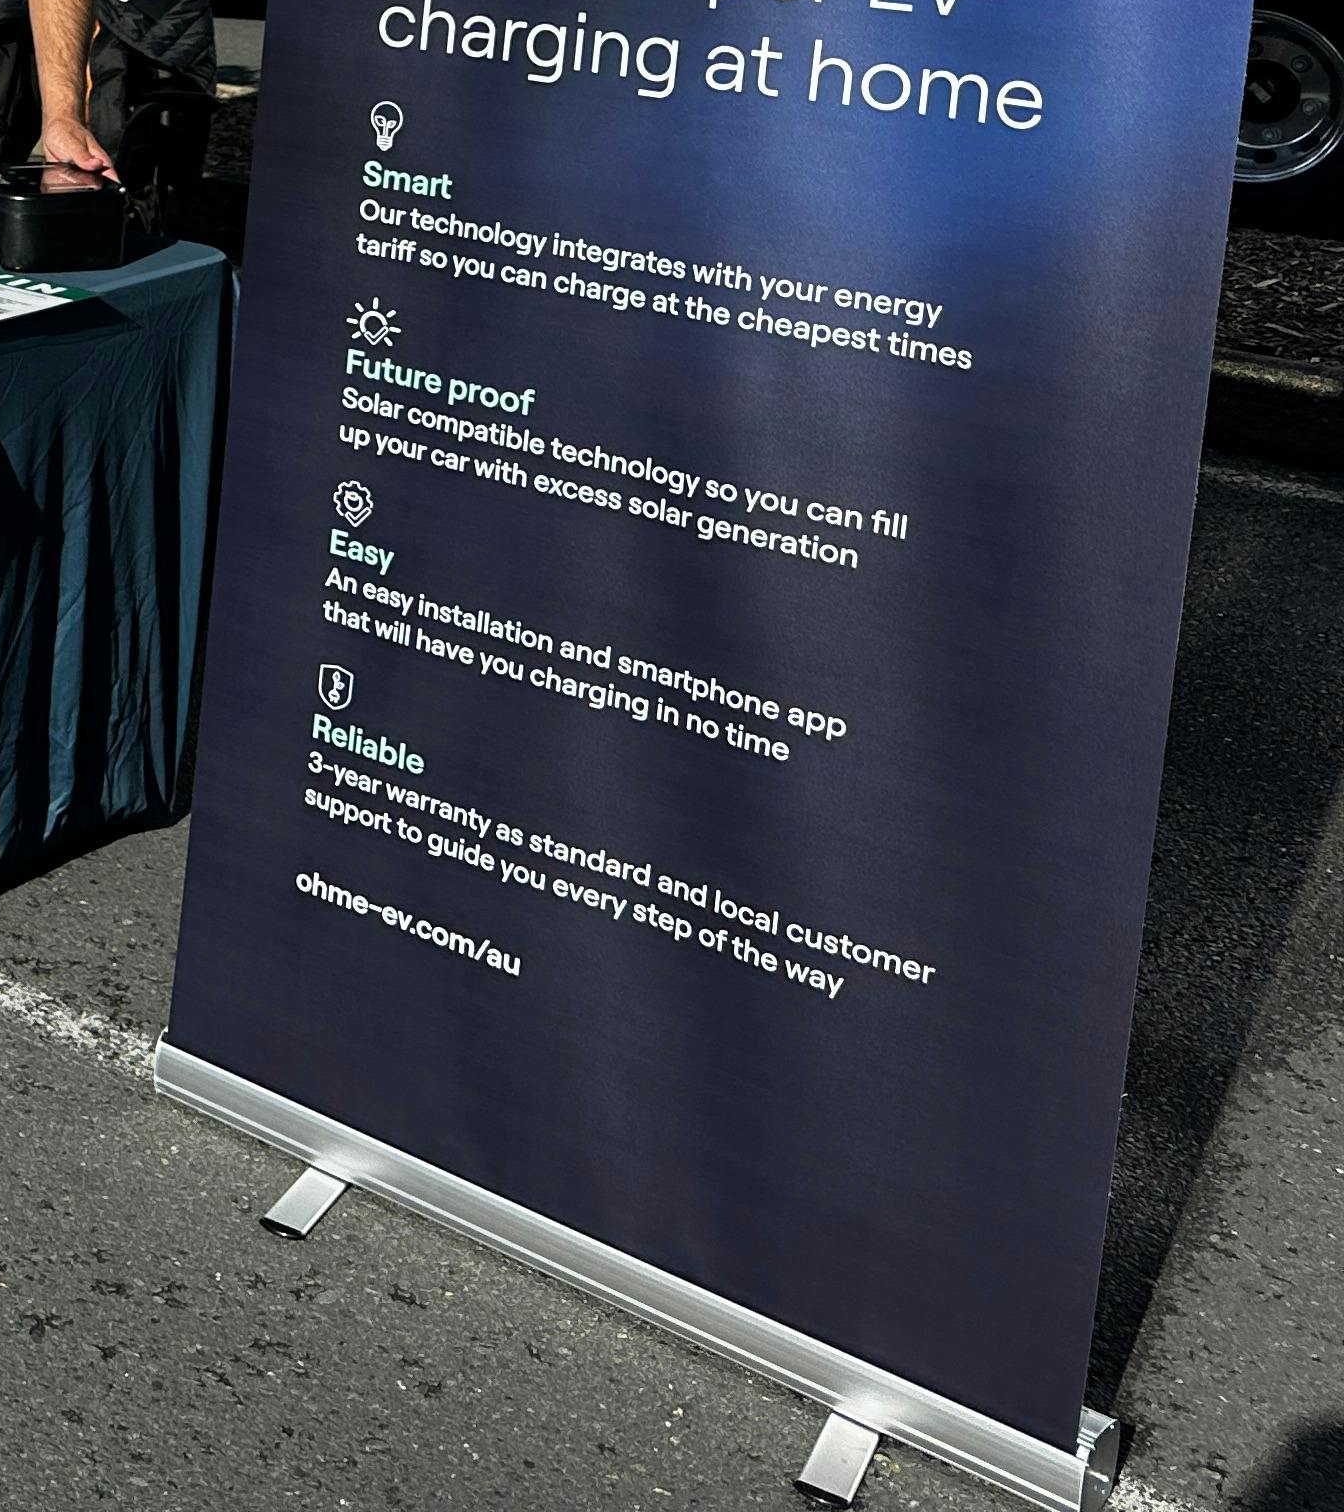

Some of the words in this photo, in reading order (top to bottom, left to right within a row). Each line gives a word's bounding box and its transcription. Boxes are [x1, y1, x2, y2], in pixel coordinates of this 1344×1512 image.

[705, 36, 783, 97] at
[808, 38, 1043, 130] home
[362, 160, 453, 200] Smart
[355, 232, 417, 263] tariff
[419, 248, 448, 269] so
[452, 254, 496, 280] you
[500, 265, 547, 290] can
[553, 271, 647, 311] charge
[652, 292, 680, 316] at
[684, 296, 731, 326] the
[737, 307, 882, 353] cheapest
[887, 331, 973, 370] times
[359, 198, 407, 226] Our
[409, 207, 548, 258] technology
[552, 232, 686, 279] integrates
[692, 261, 753, 292] with
[759, 275, 829, 303] your
[834, 288, 943, 329] energy
[345, 348, 442, 394] Future
[447, 378, 536, 416] proof
[339, 424, 371, 451] up
[375, 433, 428, 461] your
[430, 448, 471, 473] car
[473, 458, 528, 488] with
[533, 474, 623, 510] excess
[628, 496, 693, 528] solar
[696, 515, 859, 569] generation
[341, 386, 405, 420] Solar
[407, 407, 546, 455] compatible
[550, 437, 701, 498] technology
[704, 479, 738, 503] so
[744, 487, 799, 517] you
[806, 502, 863, 531] can
[870, 509, 908, 540] fill
[329, 528, 395, 576] Easy
[322, 600, 371, 634] that
[374, 619, 412, 647] will
[415, 627, 475, 665] have
[479, 651, 524, 681] you
[529, 666, 650, 722] charging
[656, 696, 680, 727] in
[685, 712, 720, 739] no
[724, 722, 790, 761] time
[324, 567, 358, 595] An
[362, 582, 414, 617] easy
[417, 593, 554, 654] installation
[559, 640, 612, 670] and
[617, 655, 780, 720] smartphone
[787, 707, 847, 741] app
[312, 712, 425, 775] Reliable
[295, 871, 521, 977] ohme-ev.com/au
[304, 788, 393, 835] support
[395, 817, 423, 844] to
[427, 833, 496, 872] guide
[500, 859, 546, 891] you
[552, 878, 628, 921] every
[632, 903, 693, 942] step
[698, 928, 729, 953] of
[731, 936, 778, 972] the
[784, 959, 845, 1000] way
[307, 750, 383, 795] 3-year
[385, 782, 492, 839] warranty
[495, 822, 524, 847] as
[528, 834, 652, 887] standard
[657, 875, 708, 909] and
[713, 889, 779, 936] local
[785, 923, 937, 985] customer
